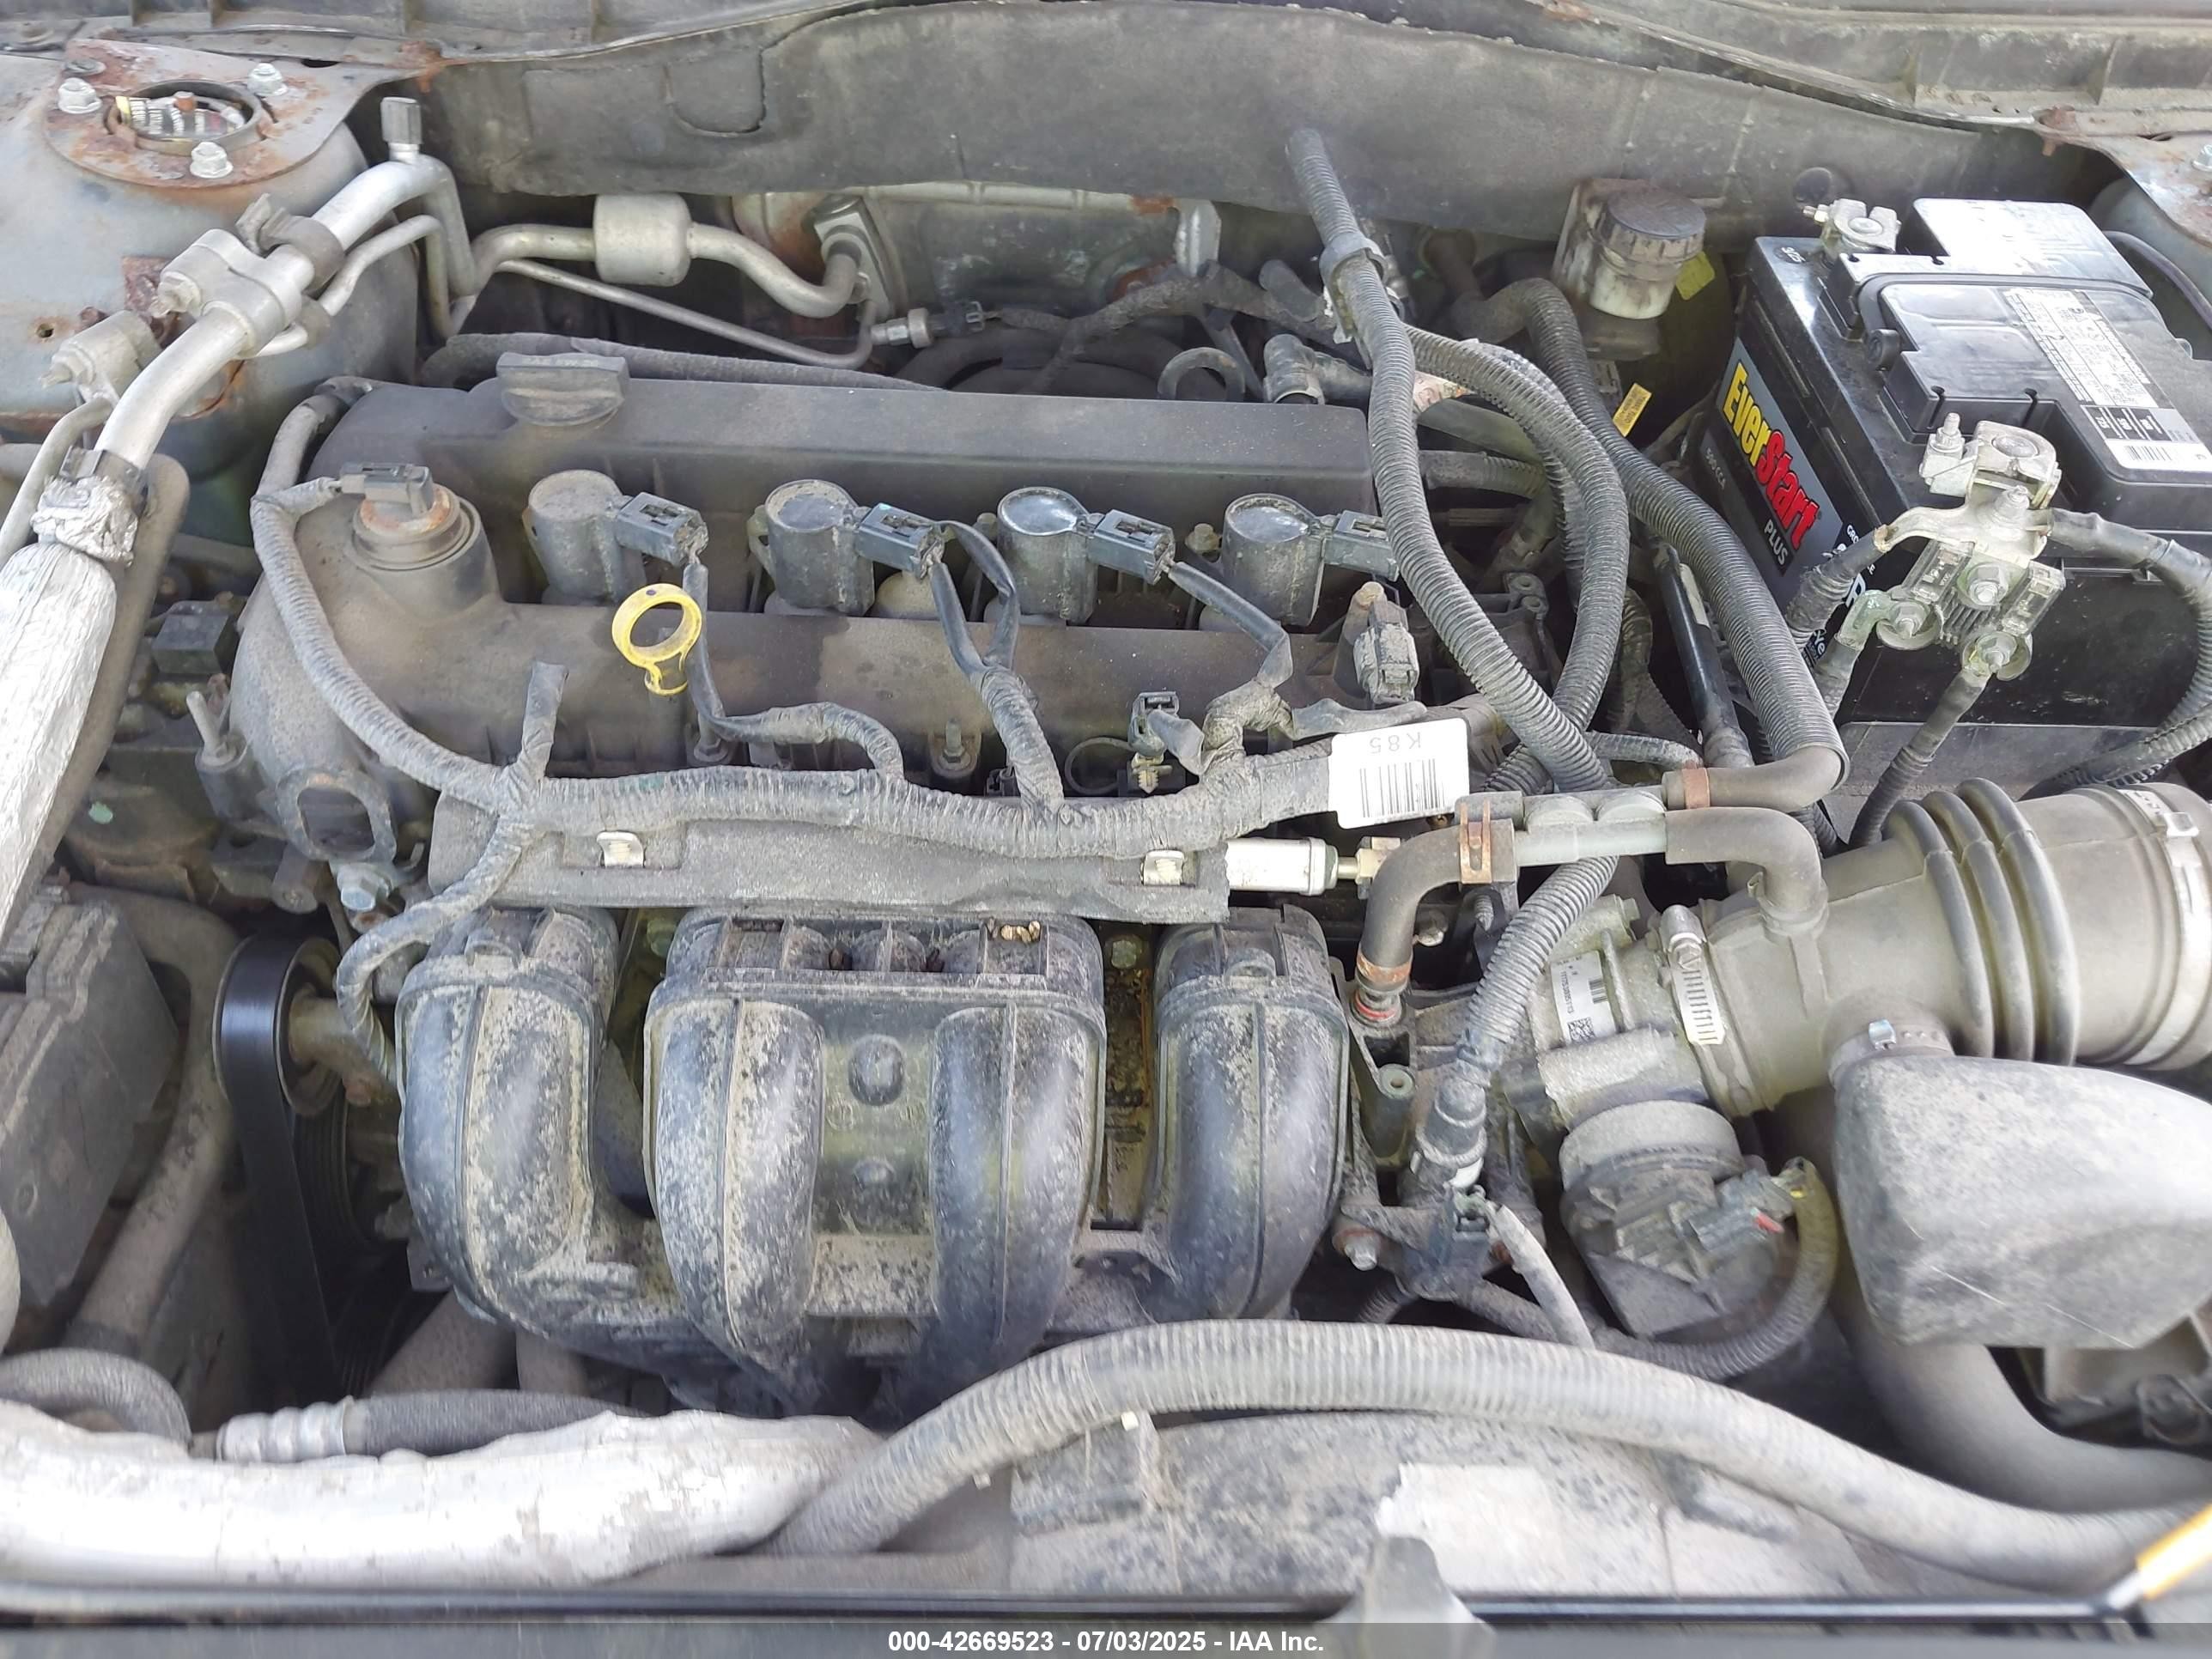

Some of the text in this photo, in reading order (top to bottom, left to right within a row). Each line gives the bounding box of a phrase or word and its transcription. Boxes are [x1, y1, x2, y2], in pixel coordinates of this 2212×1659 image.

[1723, 361, 1820, 551] EverStart
[1764, 519, 1789, 566] PLUS
[1846, 525, 1860, 543] GRO
